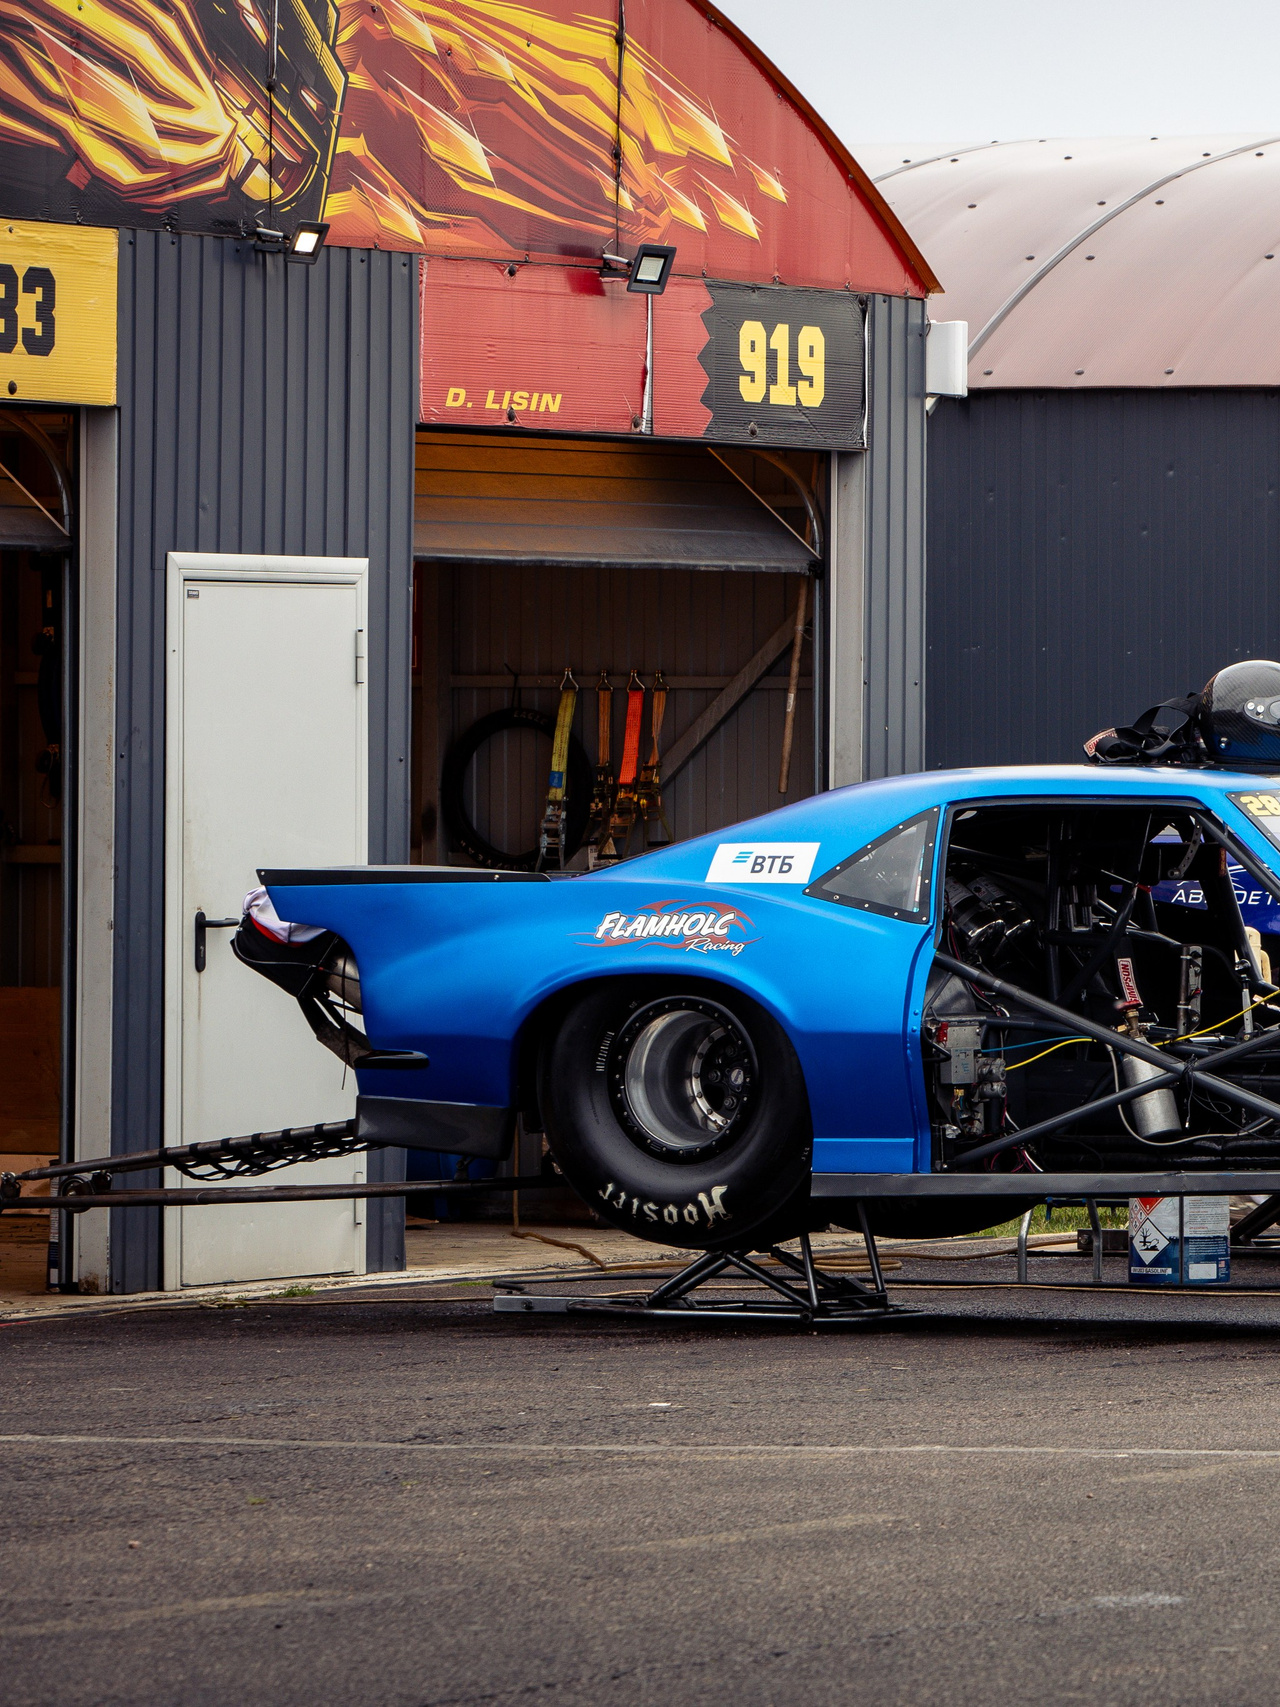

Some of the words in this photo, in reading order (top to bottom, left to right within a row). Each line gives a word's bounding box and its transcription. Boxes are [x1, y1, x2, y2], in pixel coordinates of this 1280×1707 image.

[739, 320, 825, 408] 919
[445, 387, 473, 408] D.
[485, 389, 562, 412] LISIN
[750, 855, 795, 874] ВТБ
[595, 911, 736, 939] FLAMHOLC
[685, 937, 746, 957] Racing
[598, 1182, 733, 1229] Hoosier
